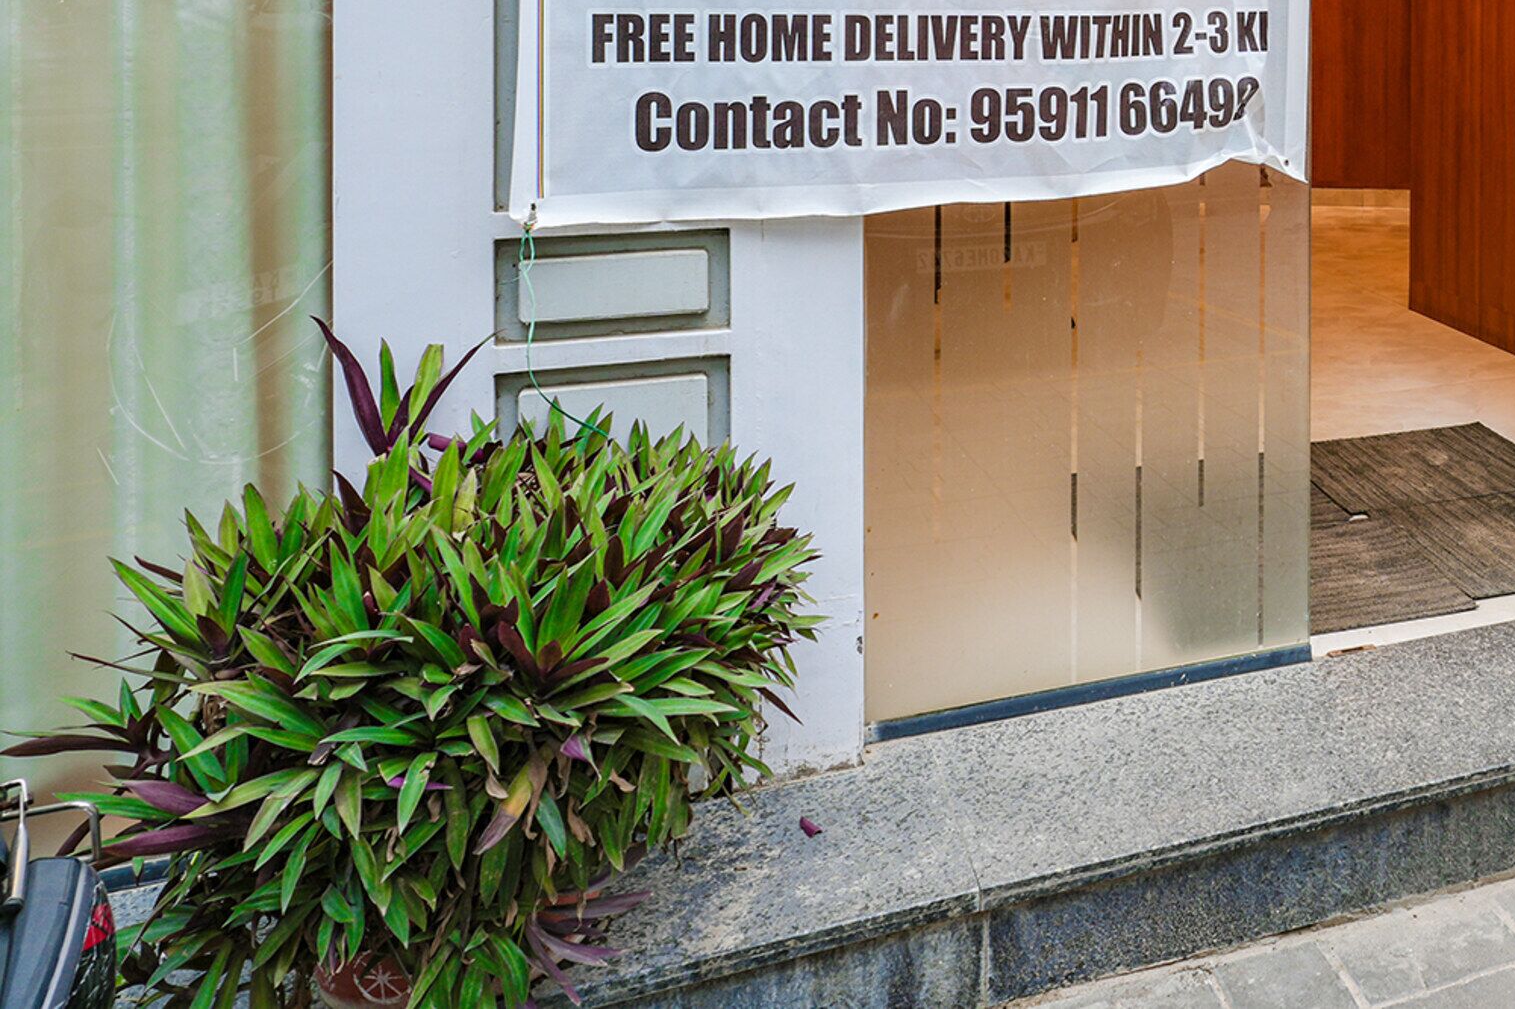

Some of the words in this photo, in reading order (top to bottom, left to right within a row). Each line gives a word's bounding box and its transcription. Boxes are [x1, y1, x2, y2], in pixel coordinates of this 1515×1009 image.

[592, 13, 695, 63] FREE
[708, 13, 832, 63] HOME
[844, 13, 1032, 62] DELIVERY
[1039, 12, 1163, 60] WITHIN
[1172, 10, 1230, 55] 2-3
[635, 91, 862, 152] Contact
[876, 89, 957, 146] No:
[970, 84, 1109, 144] 95911
